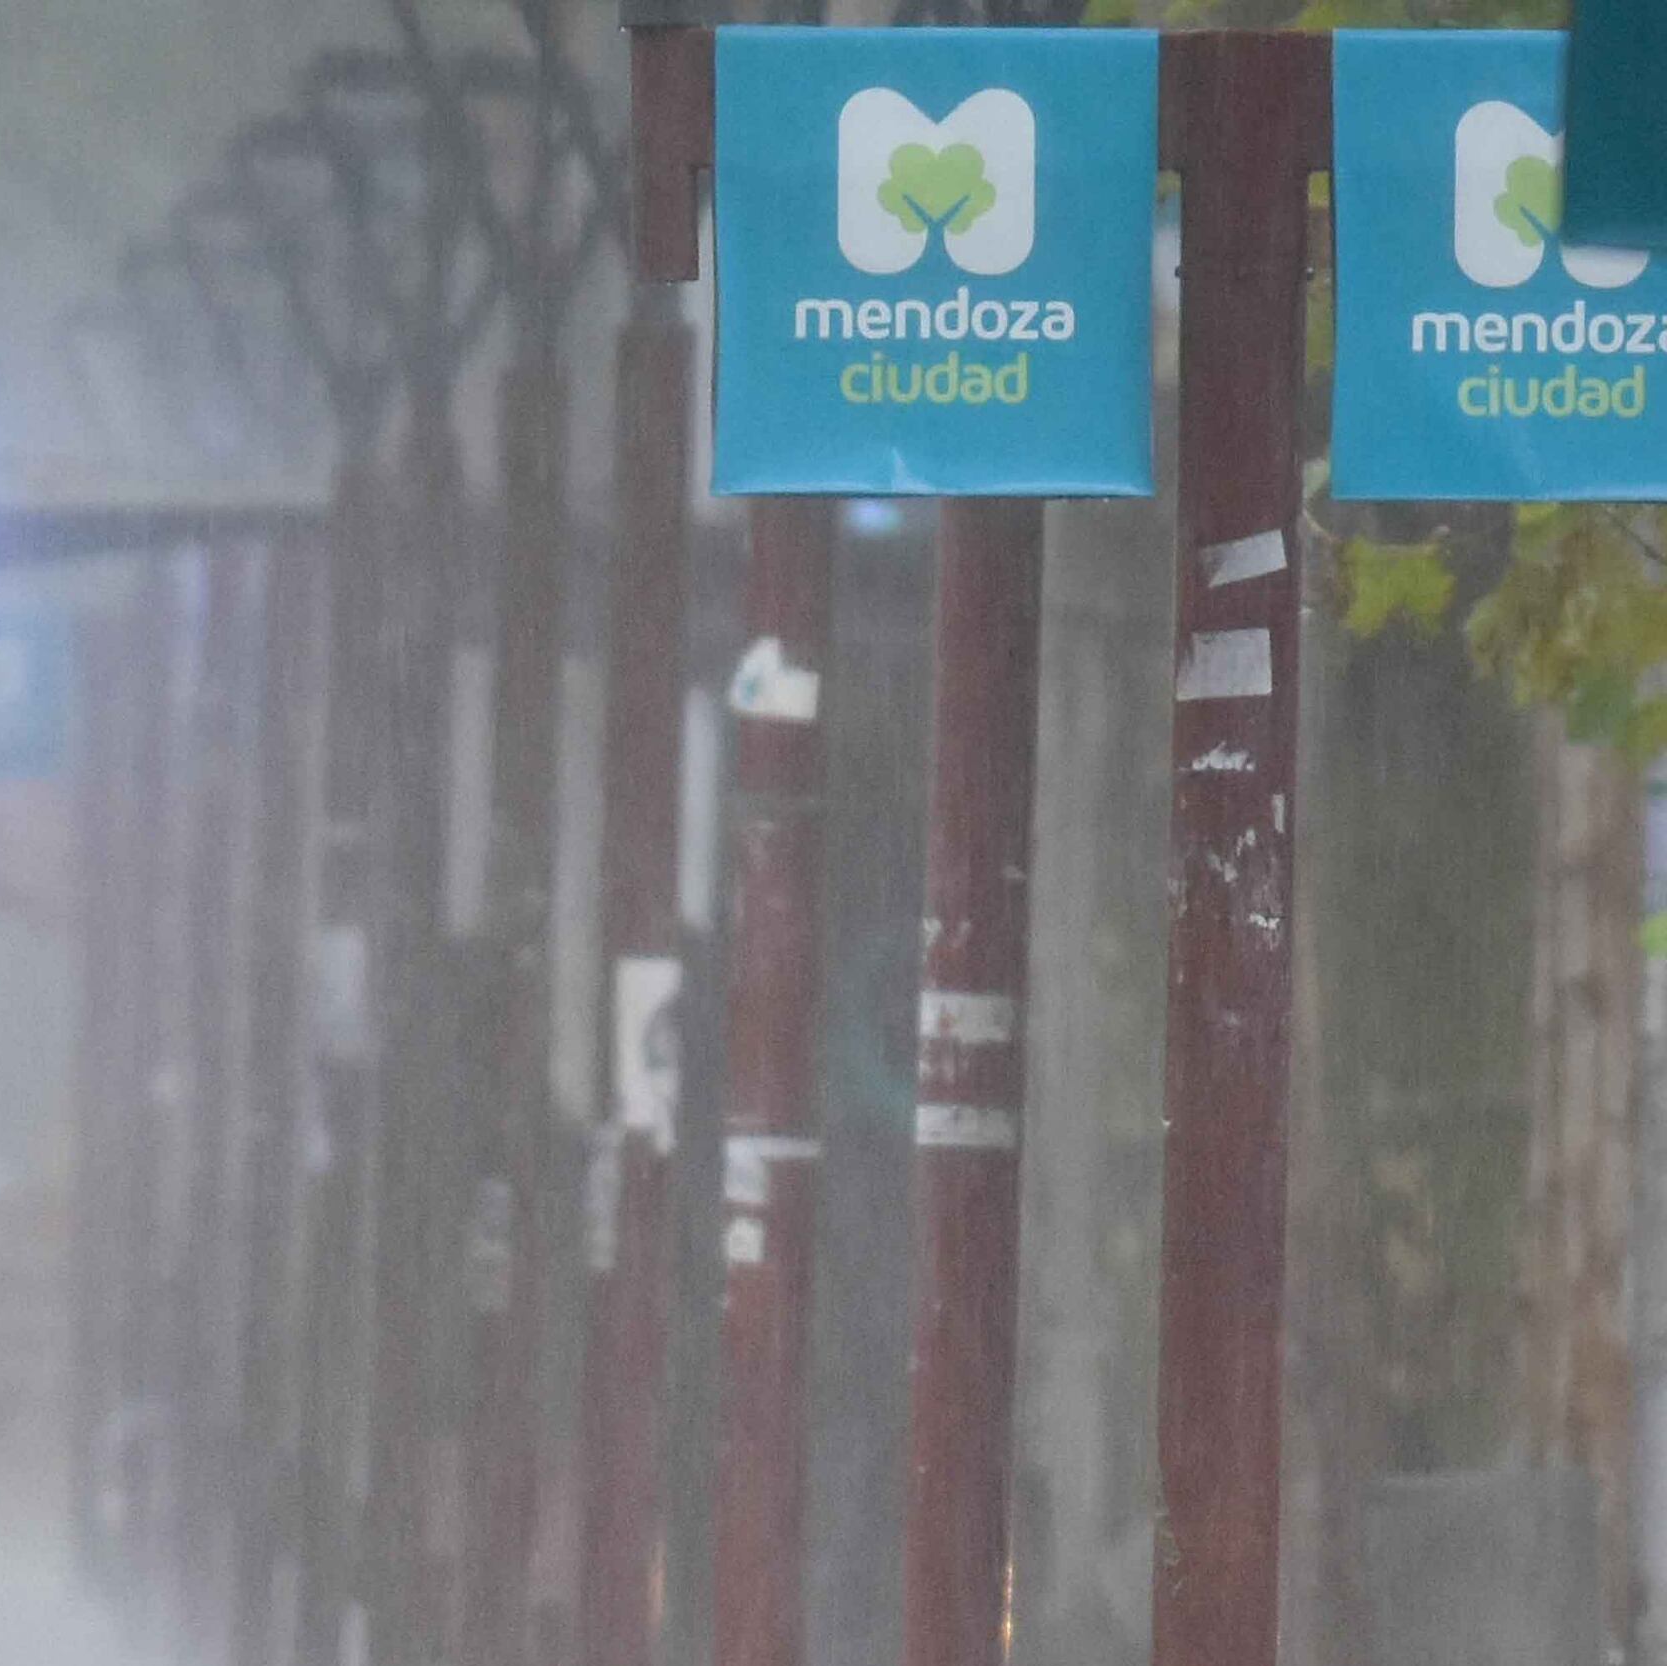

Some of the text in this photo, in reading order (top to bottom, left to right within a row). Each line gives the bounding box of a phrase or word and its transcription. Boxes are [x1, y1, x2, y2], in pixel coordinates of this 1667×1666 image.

[794, 286, 1076, 340] mendoza
[1411, 300, 1667, 354] mendoz
[839, 350, 1030, 404] ciudad
[1457, 365, 1646, 418] ciudad
